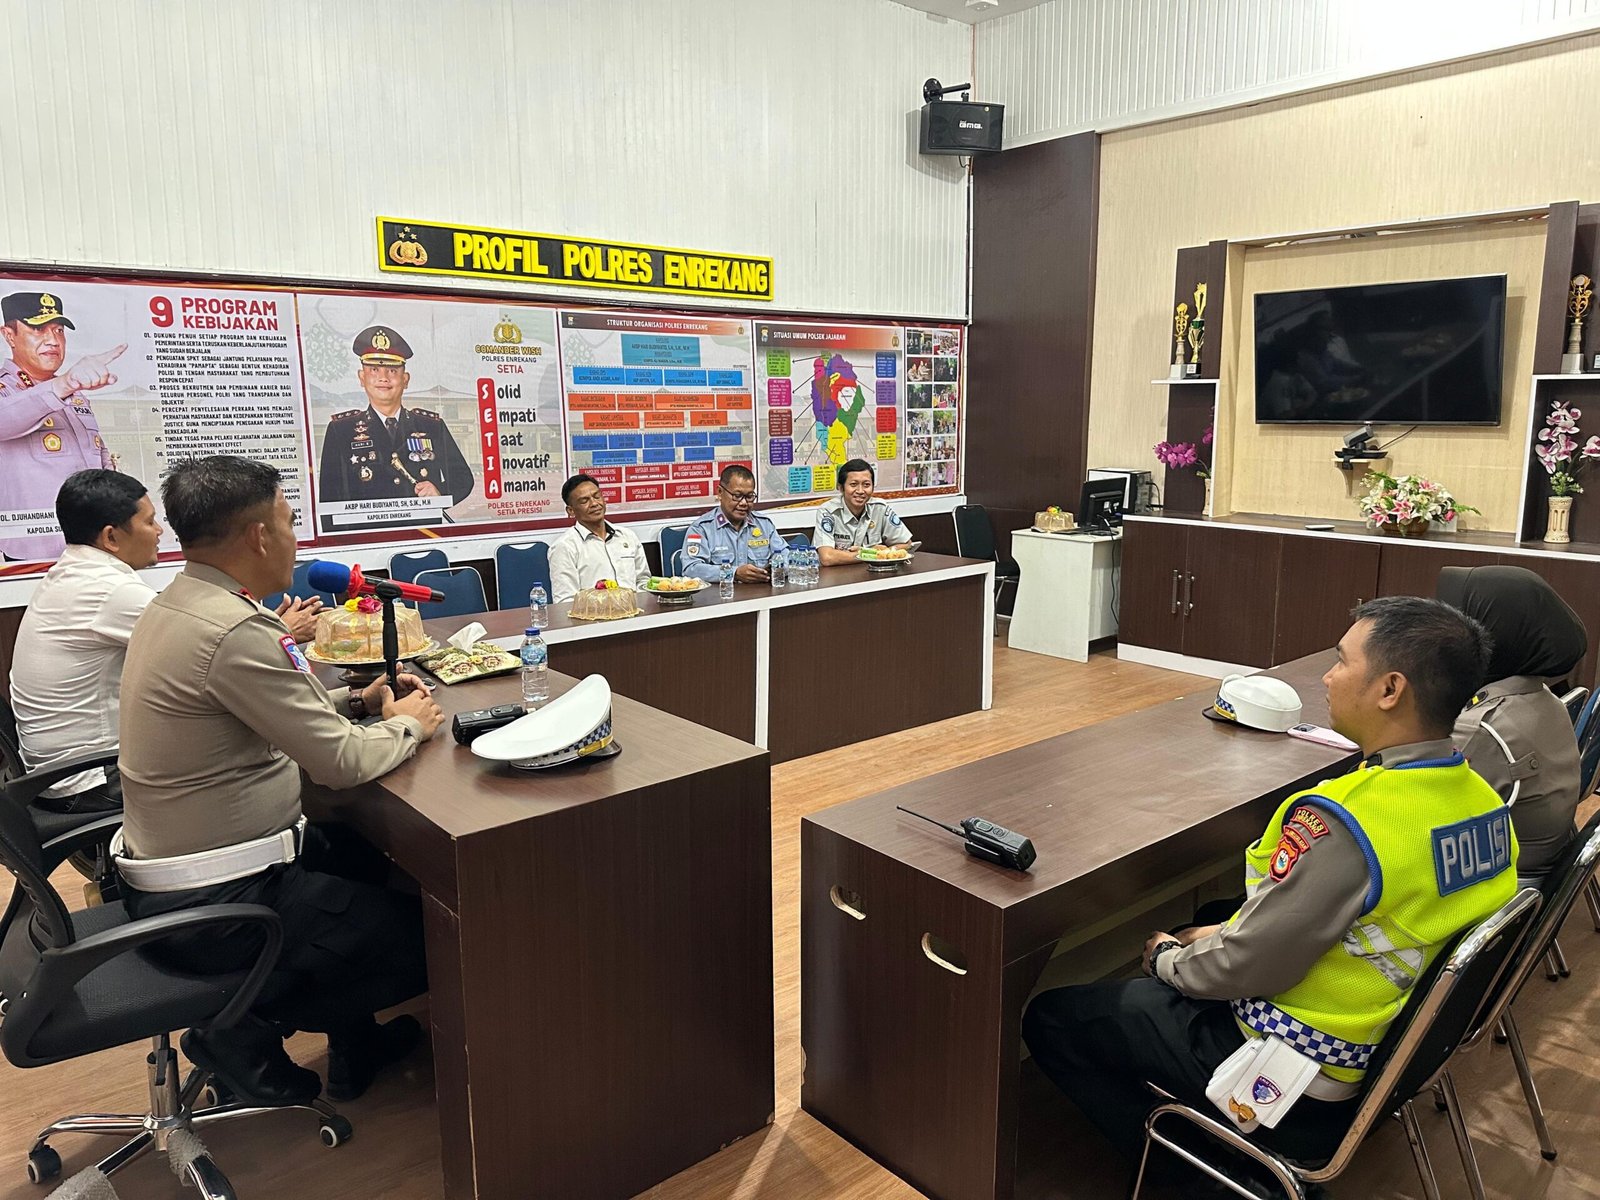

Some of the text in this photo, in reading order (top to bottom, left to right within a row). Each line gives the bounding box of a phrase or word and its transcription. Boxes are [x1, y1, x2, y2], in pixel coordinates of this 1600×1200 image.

[453, 233, 768, 292] PROFIL POLRES ENREKANG
[150, 296, 277, 327] 9 PROGRAM
[183, 315, 278, 330] KEBIJAKAN
[475, 345, 542, 356] COMANDER WISH
[497, 365, 523, 373] SETIA
[515, 499, 550, 508] ENREKANG
[12, 512, 54, 521] DJUHANDHANI
[518, 507, 542, 515] PRESISI
[1298, 810, 1324, 830] POLRES
[1440, 813, 1511, 887] POLISI
